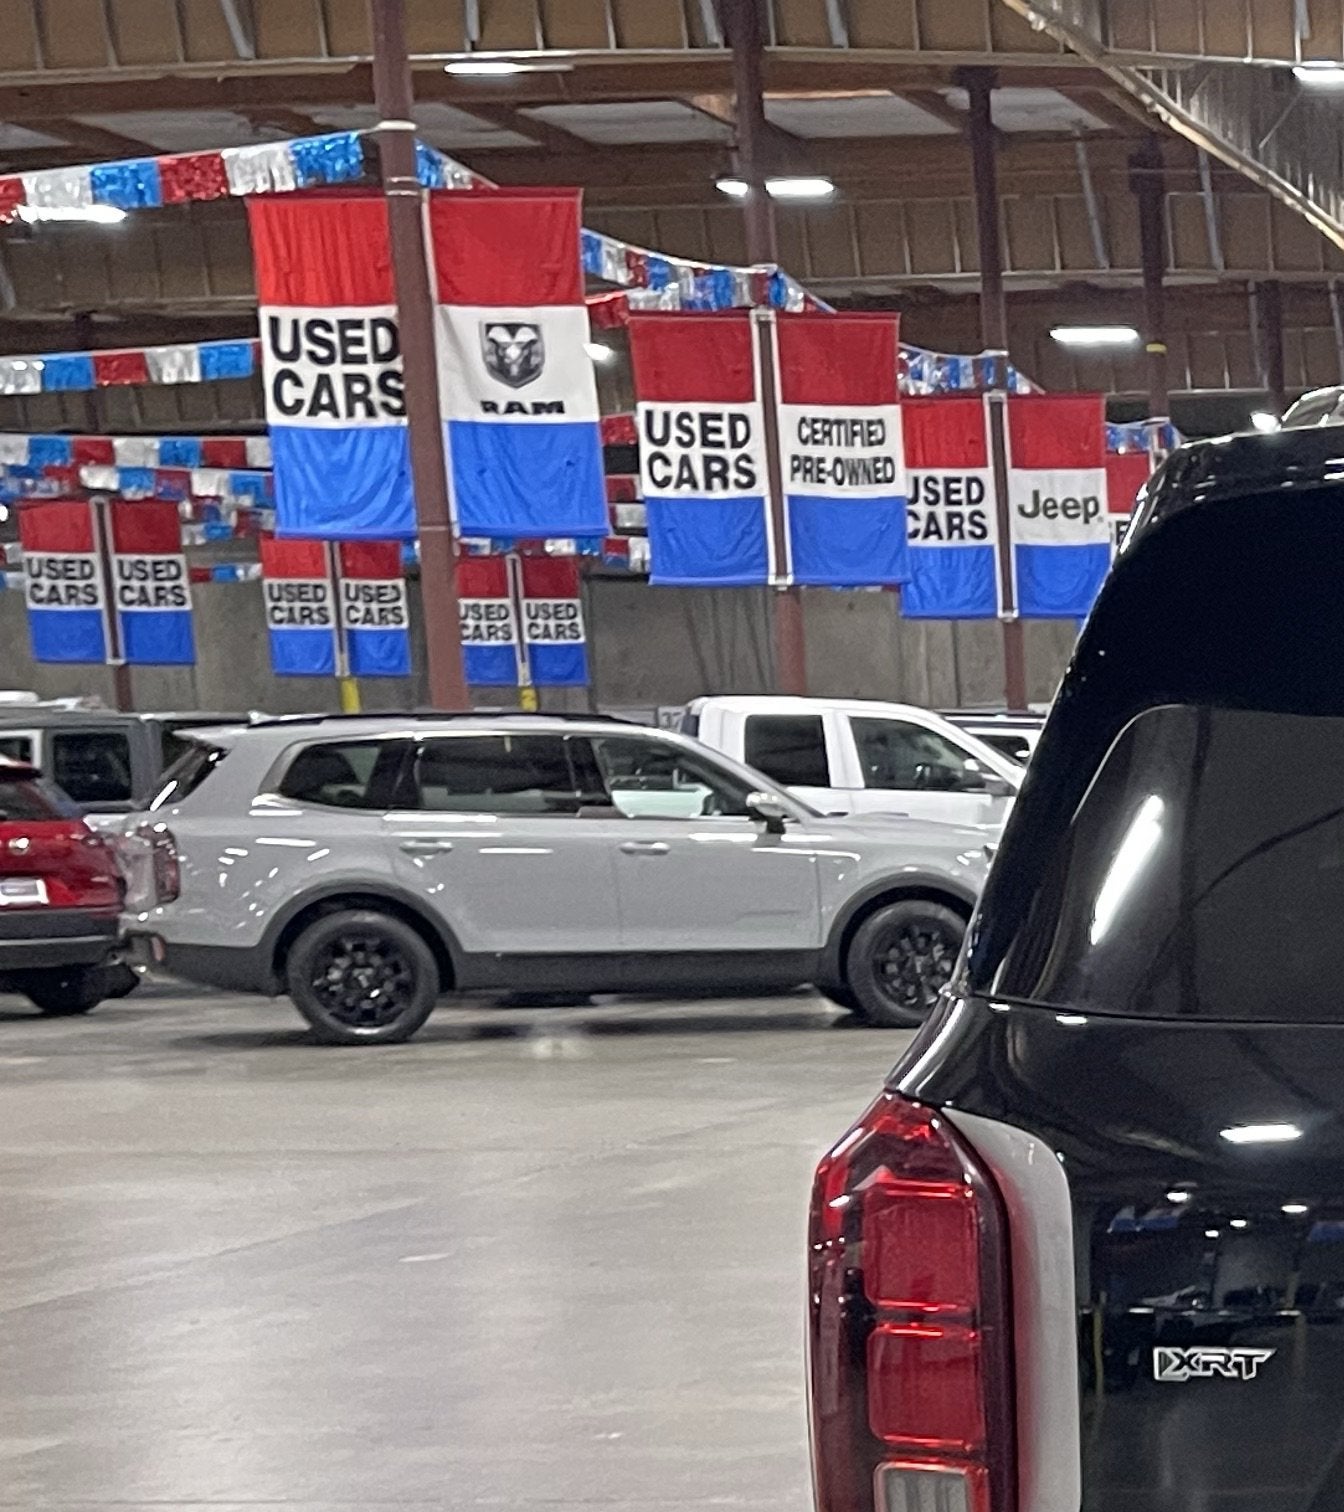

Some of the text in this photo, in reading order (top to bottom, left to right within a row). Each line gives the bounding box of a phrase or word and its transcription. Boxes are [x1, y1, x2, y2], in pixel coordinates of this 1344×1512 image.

[269, 316, 400, 367] USED
[272, 368, 407, 419] CARS
[479, 399, 566, 415] RAM
[644, 410, 751, 449] USED
[797, 416, 886, 448] CERTIFIED
[647, 452, 757, 492] CARS
[789, 455, 896, 487] PRE-OWNED
[1017, 488, 1100, 525] Jeep
[27, 557, 95, 581] USED
[118, 558, 182, 582] USED
[29, 582, 99, 606] CARS
[118, 584, 188, 607] CARS
[268, 582, 327, 603] USED
[345, 582, 402, 603] USED
[270, 605, 330, 625] CARS
[346, 604, 404, 625] CARS
[525, 602, 578, 620] USED
[527, 621, 582, 640] CARS
[1154, 1346, 1278, 1382] XRT
